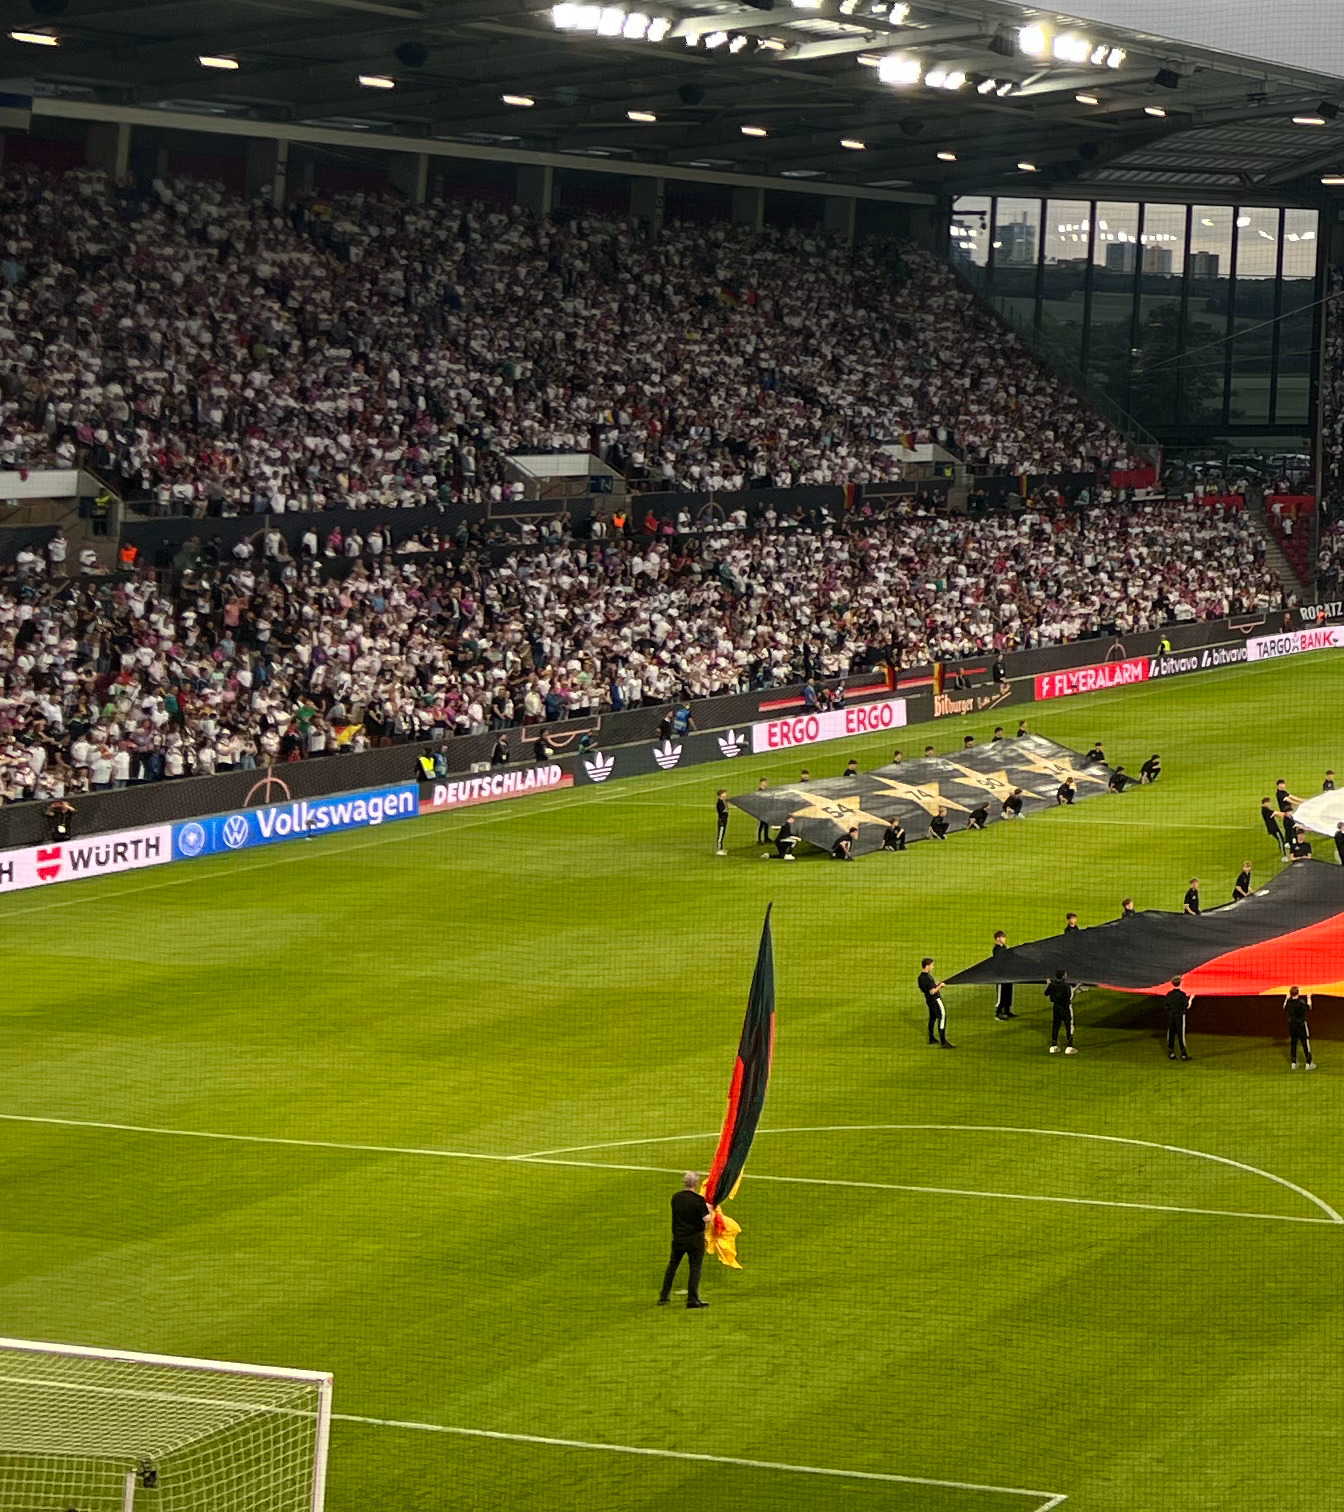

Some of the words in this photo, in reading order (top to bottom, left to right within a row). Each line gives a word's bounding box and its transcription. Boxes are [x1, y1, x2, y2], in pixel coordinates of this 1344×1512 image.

[1055, 661, 1143, 697] FLYERALARM
[1160, 656, 1199, 675] bitvavo
[1212, 648, 1248, 666] bitvavo
[768, 716, 820, 748] ERGO
[845, 703, 893, 734] ERGO
[433, 764, 563, 806] DEUTSCHLAND
[256, 789, 414, 839] Volkswagen
[823, 802, 857, 819] 54
[69, 834, 161, 872] WÜRTH
